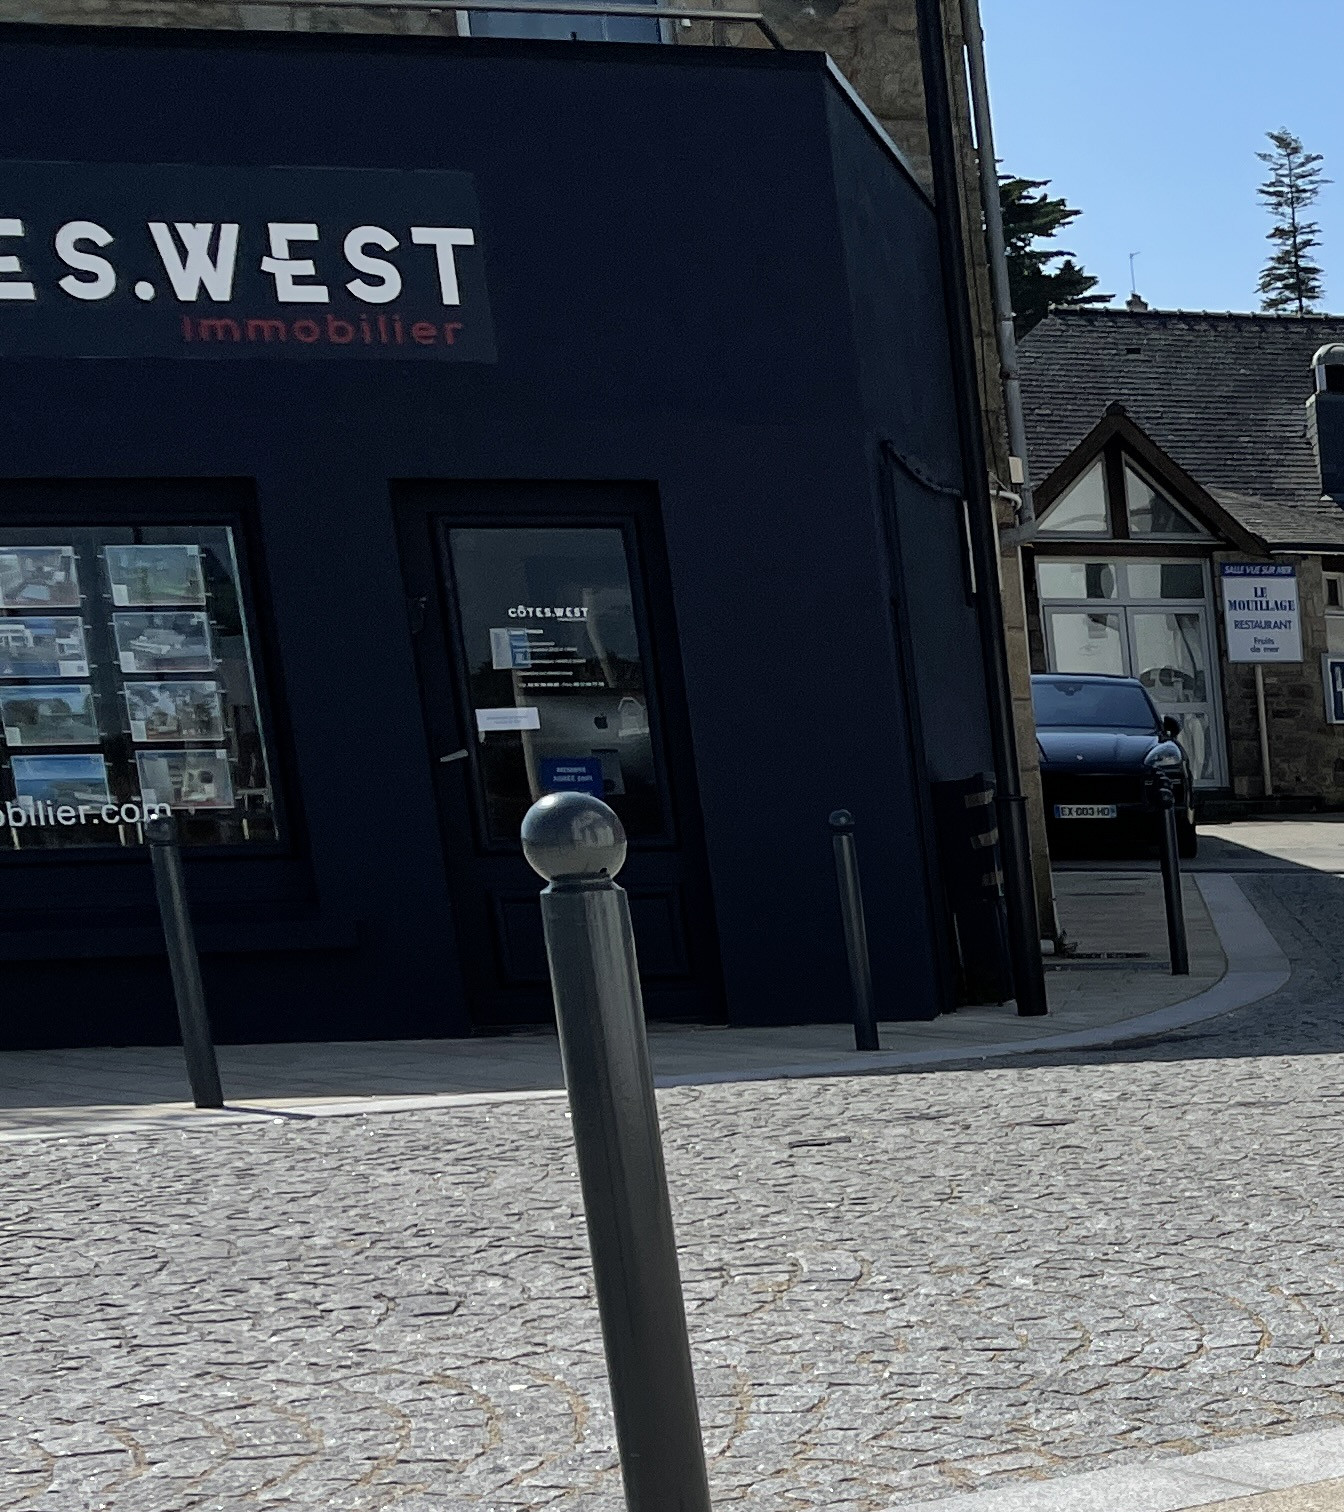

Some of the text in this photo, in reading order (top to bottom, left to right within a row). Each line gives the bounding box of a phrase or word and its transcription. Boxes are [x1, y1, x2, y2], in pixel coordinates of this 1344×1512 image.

[1254, 586, 1268, 599] LE
[1228, 599, 1296, 612] MOUILLAGE
[1233, 619, 1292, 630] RESTAURANT
[1254, 636, 1275, 645] Fruits
[1250, 645, 1261, 653] de
[0, 800, 171, 828] bilier.com
